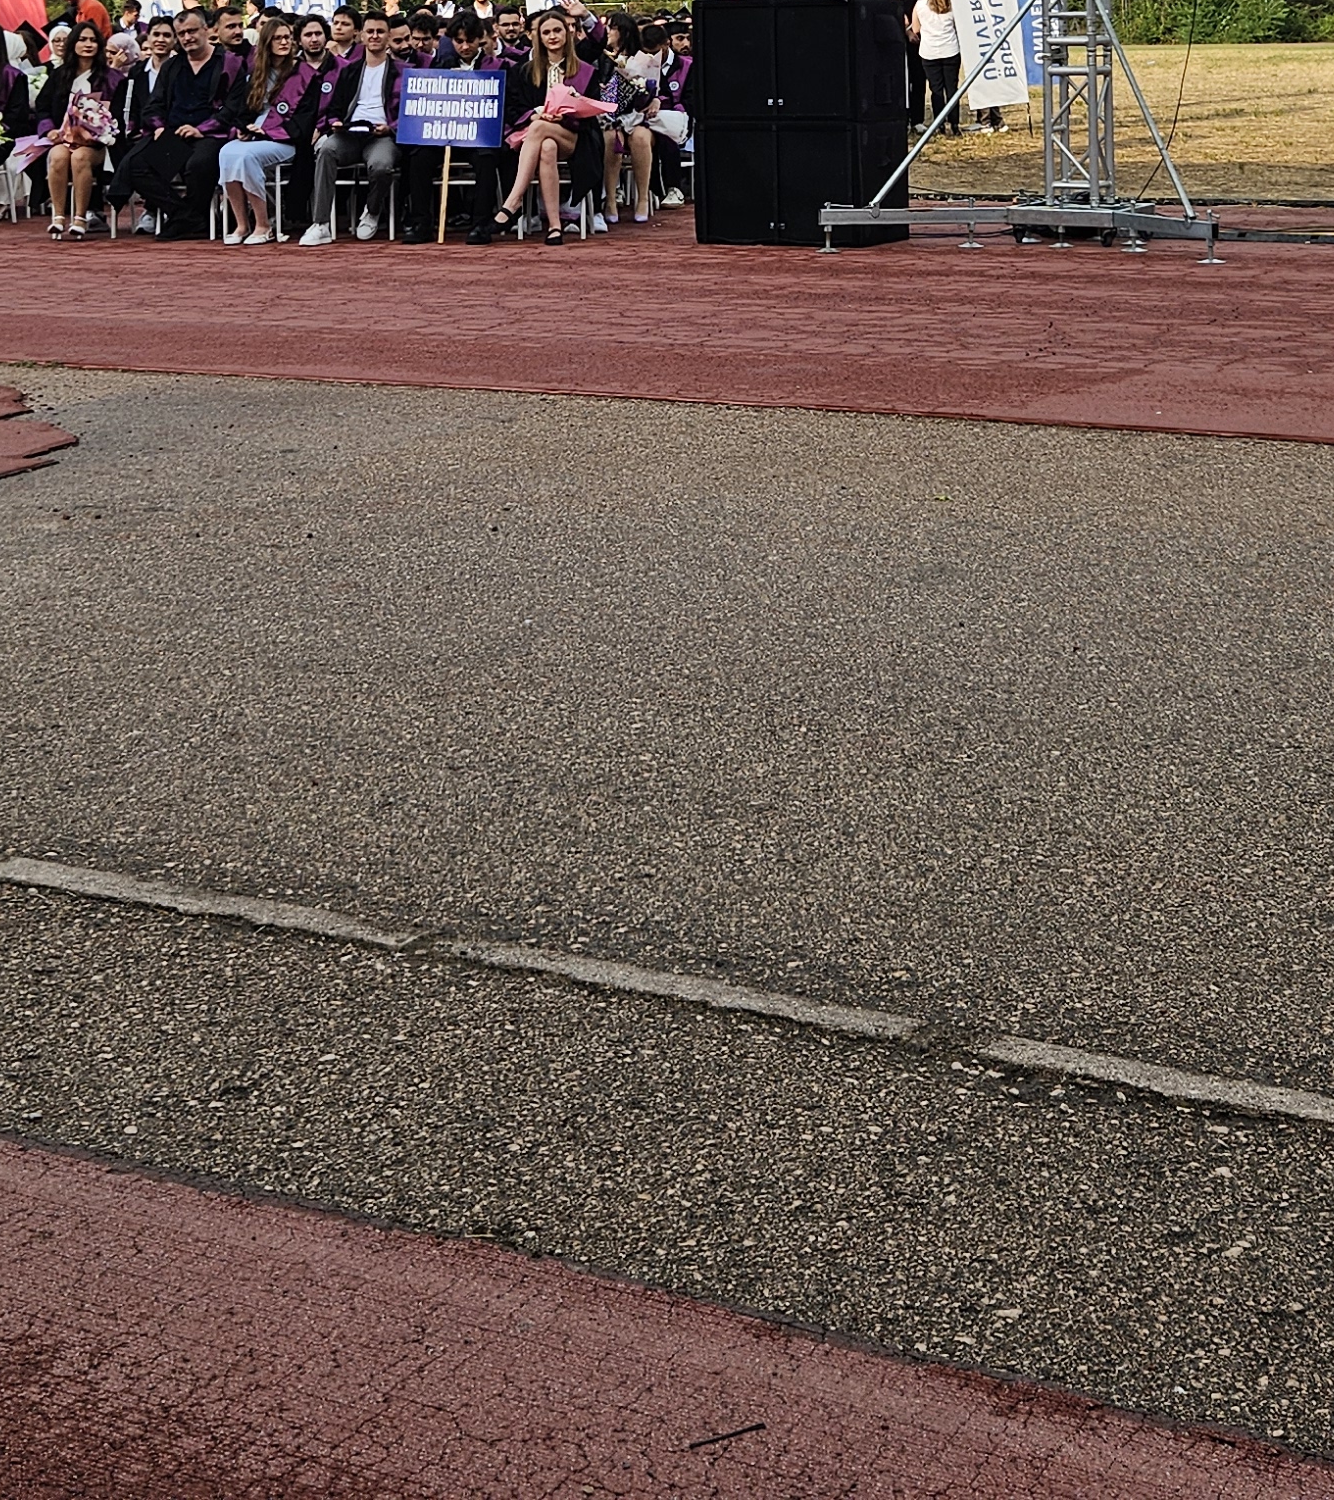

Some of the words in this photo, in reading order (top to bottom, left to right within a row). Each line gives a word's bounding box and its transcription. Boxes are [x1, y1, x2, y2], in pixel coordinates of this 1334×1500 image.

[407, 75, 447, 95] ELEKTRİK
[448, 76, 500, 96] ELEKTRONİK
[404, 97, 499, 119] MÜHENDİSLİĞİ
[422, 120, 478, 141] BÖLÜMÜ
